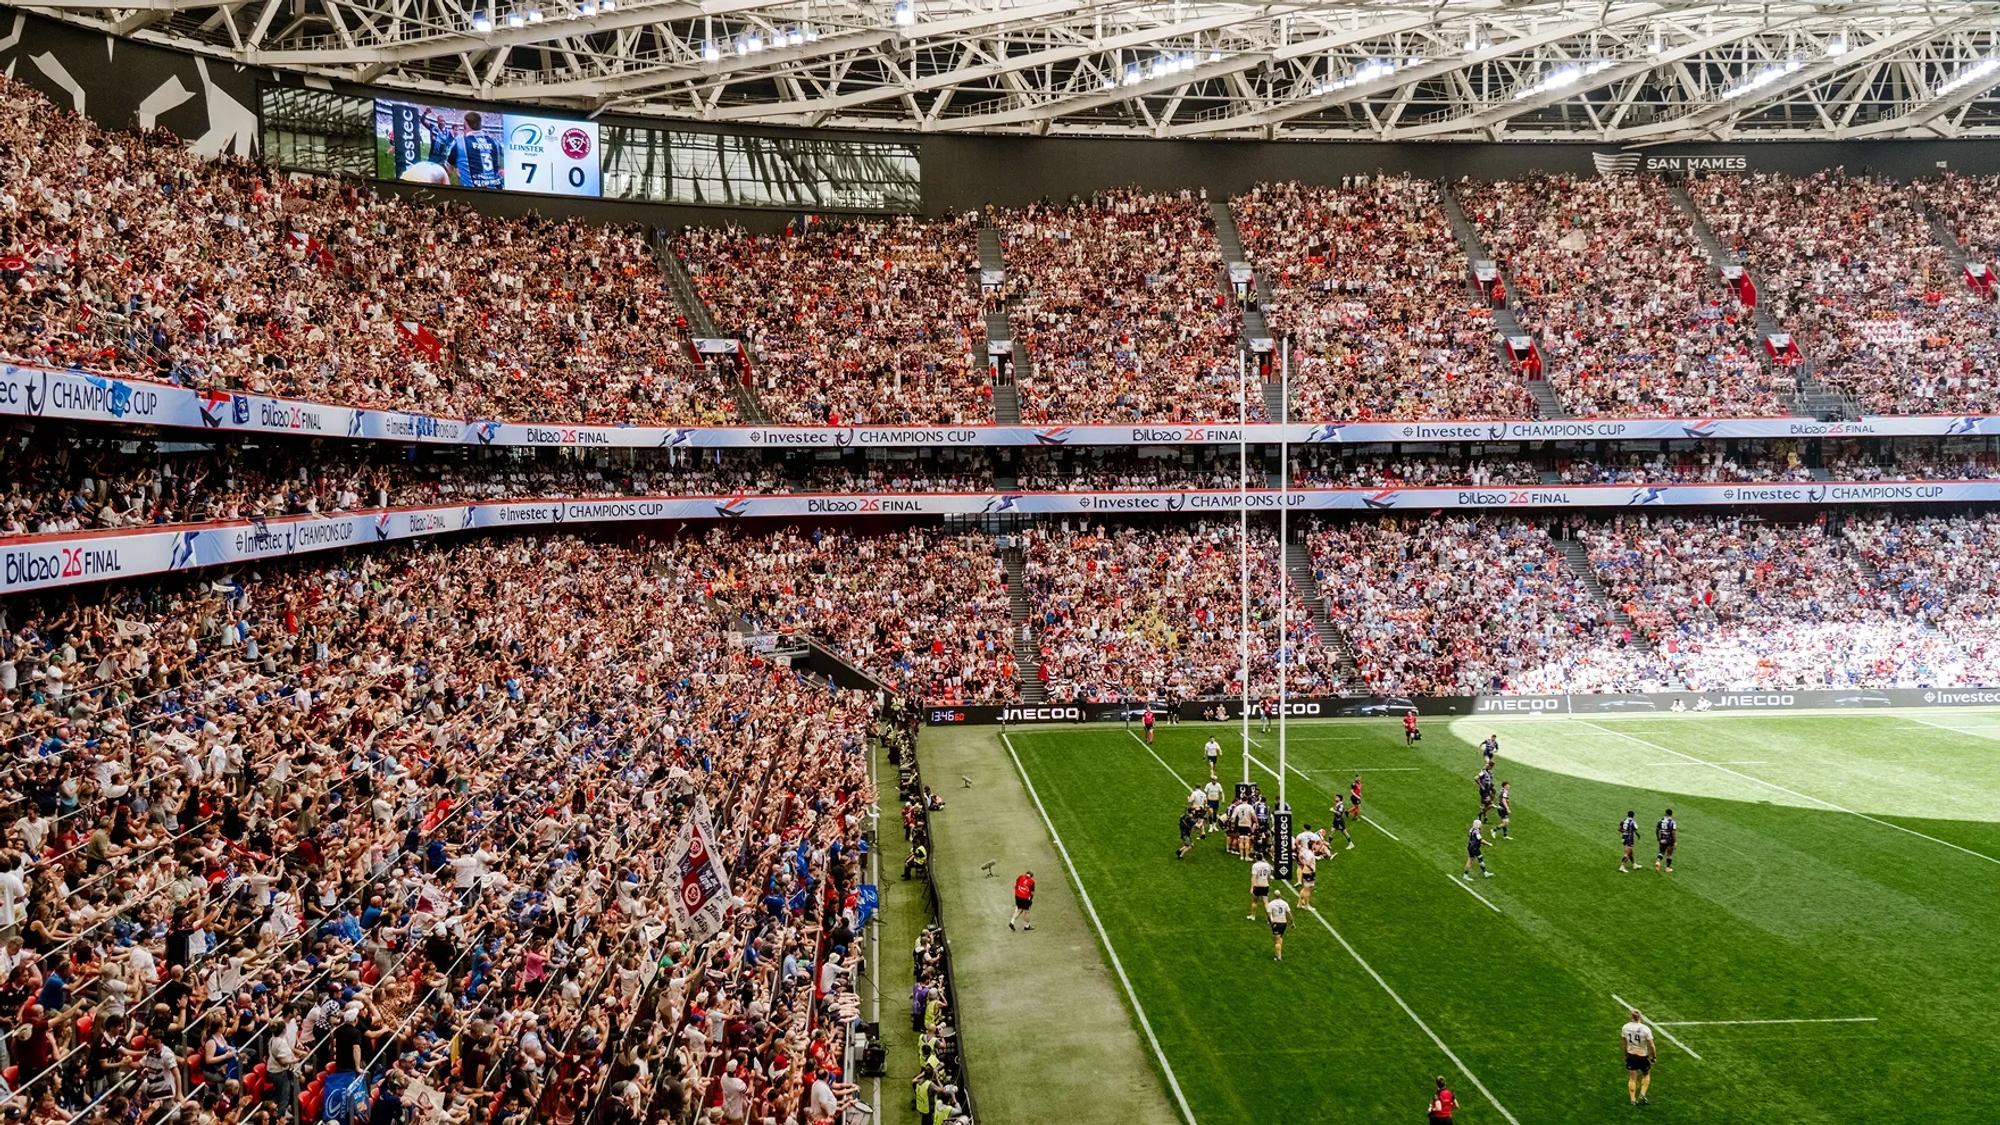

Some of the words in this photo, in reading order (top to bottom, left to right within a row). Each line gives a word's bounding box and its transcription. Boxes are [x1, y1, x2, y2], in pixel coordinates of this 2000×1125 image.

[402, 109, 415, 166] vestec
[509, 144, 545, 153] LEINSTER
[1646, 158, 1680, 169] SAN
[1687, 158, 1747, 169] MAMES
[521, 162, 538, 184] 7
[568, 166, 586, 188] 0
[53, 382, 131, 414] CHAMPIOS
[133, 391, 157, 415] CUP
[261, 403, 290, 427] Bilbao
[302, 412, 322, 430] FINAL
[1132, 429, 1182, 441] Bilbao
[1184, 429, 1205, 441] 26
[1416, 425, 1481, 438] Investec
[1512, 425, 1594, 437] CHAMPIONS
[1597, 424, 1626, 436] CUP
[1790, 424, 1828, 434] Bilbao
[1845, 425, 1875, 433] FINAL
[527, 428, 561, 443] Bilbao
[561, 429, 576, 443] 26
[578, 432, 610, 444] FINAL
[763, 431, 828, 443] Investec
[859, 431, 944, 443] CHAMPIONS
[947, 430, 977, 442] CUP
[1458, 491, 1507, 504] Bilbao
[1509, 491, 1529, 504] 26
[1531, 493, 1570, 503] FINAL
[1737, 488, 1801, 500] Investec
[1832, 487, 1913, 498] CHAMPIONS
[1916, 486, 1944, 497] CUP
[808, 499, 857, 512] Bilbao
[859, 499, 880, 511] 26
[882, 501, 922, 511] FINAL
[1093, 496, 1160, 508] Investec
[1190, 495, 1273, 507] CHAMPONS
[506, 506, 548, 521] Investec
[569, 503, 635, 518] CHAMPIONS
[638, 503, 663, 516] CUP
[299, 523, 339, 546] CHAMPIONS
[340, 522, 353, 540] CUP
[6, 552, 60, 585] Bilbao
[62, 547, 82, 578] 26
[85, 549, 121, 574] FINAL
[1477, 699, 1559, 711] JAECOO
[1714, 695, 1794, 706] JAECOO
[996, 707, 1079, 720] JAECOO
[1279, 815, 1289, 865] Investec
[1628, 1033, 1641, 1044] 14
